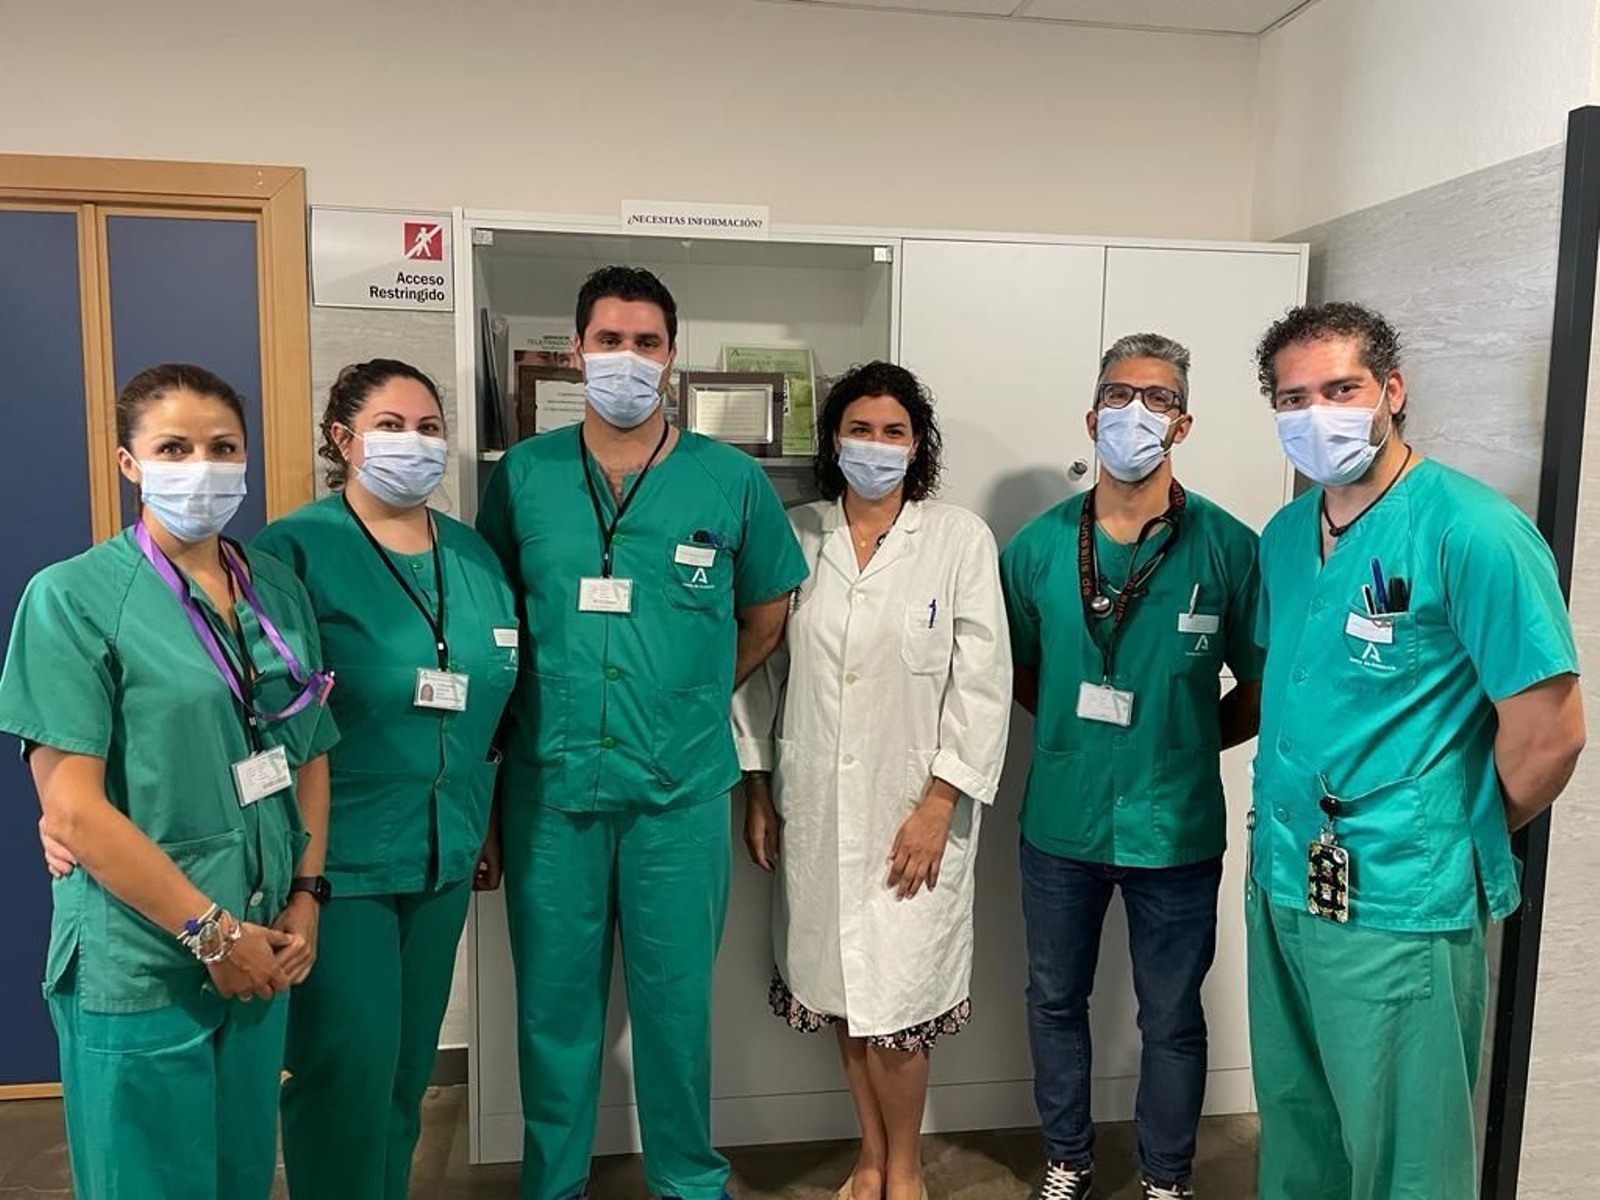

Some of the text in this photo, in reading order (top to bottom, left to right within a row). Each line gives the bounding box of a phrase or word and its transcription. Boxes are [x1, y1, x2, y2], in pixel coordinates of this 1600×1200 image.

[627, 214, 763, 228] ¿NECESITAS INFORMACIÓN?
[396, 271, 445, 286] Acceso
[369, 285, 445, 303] Restringido
